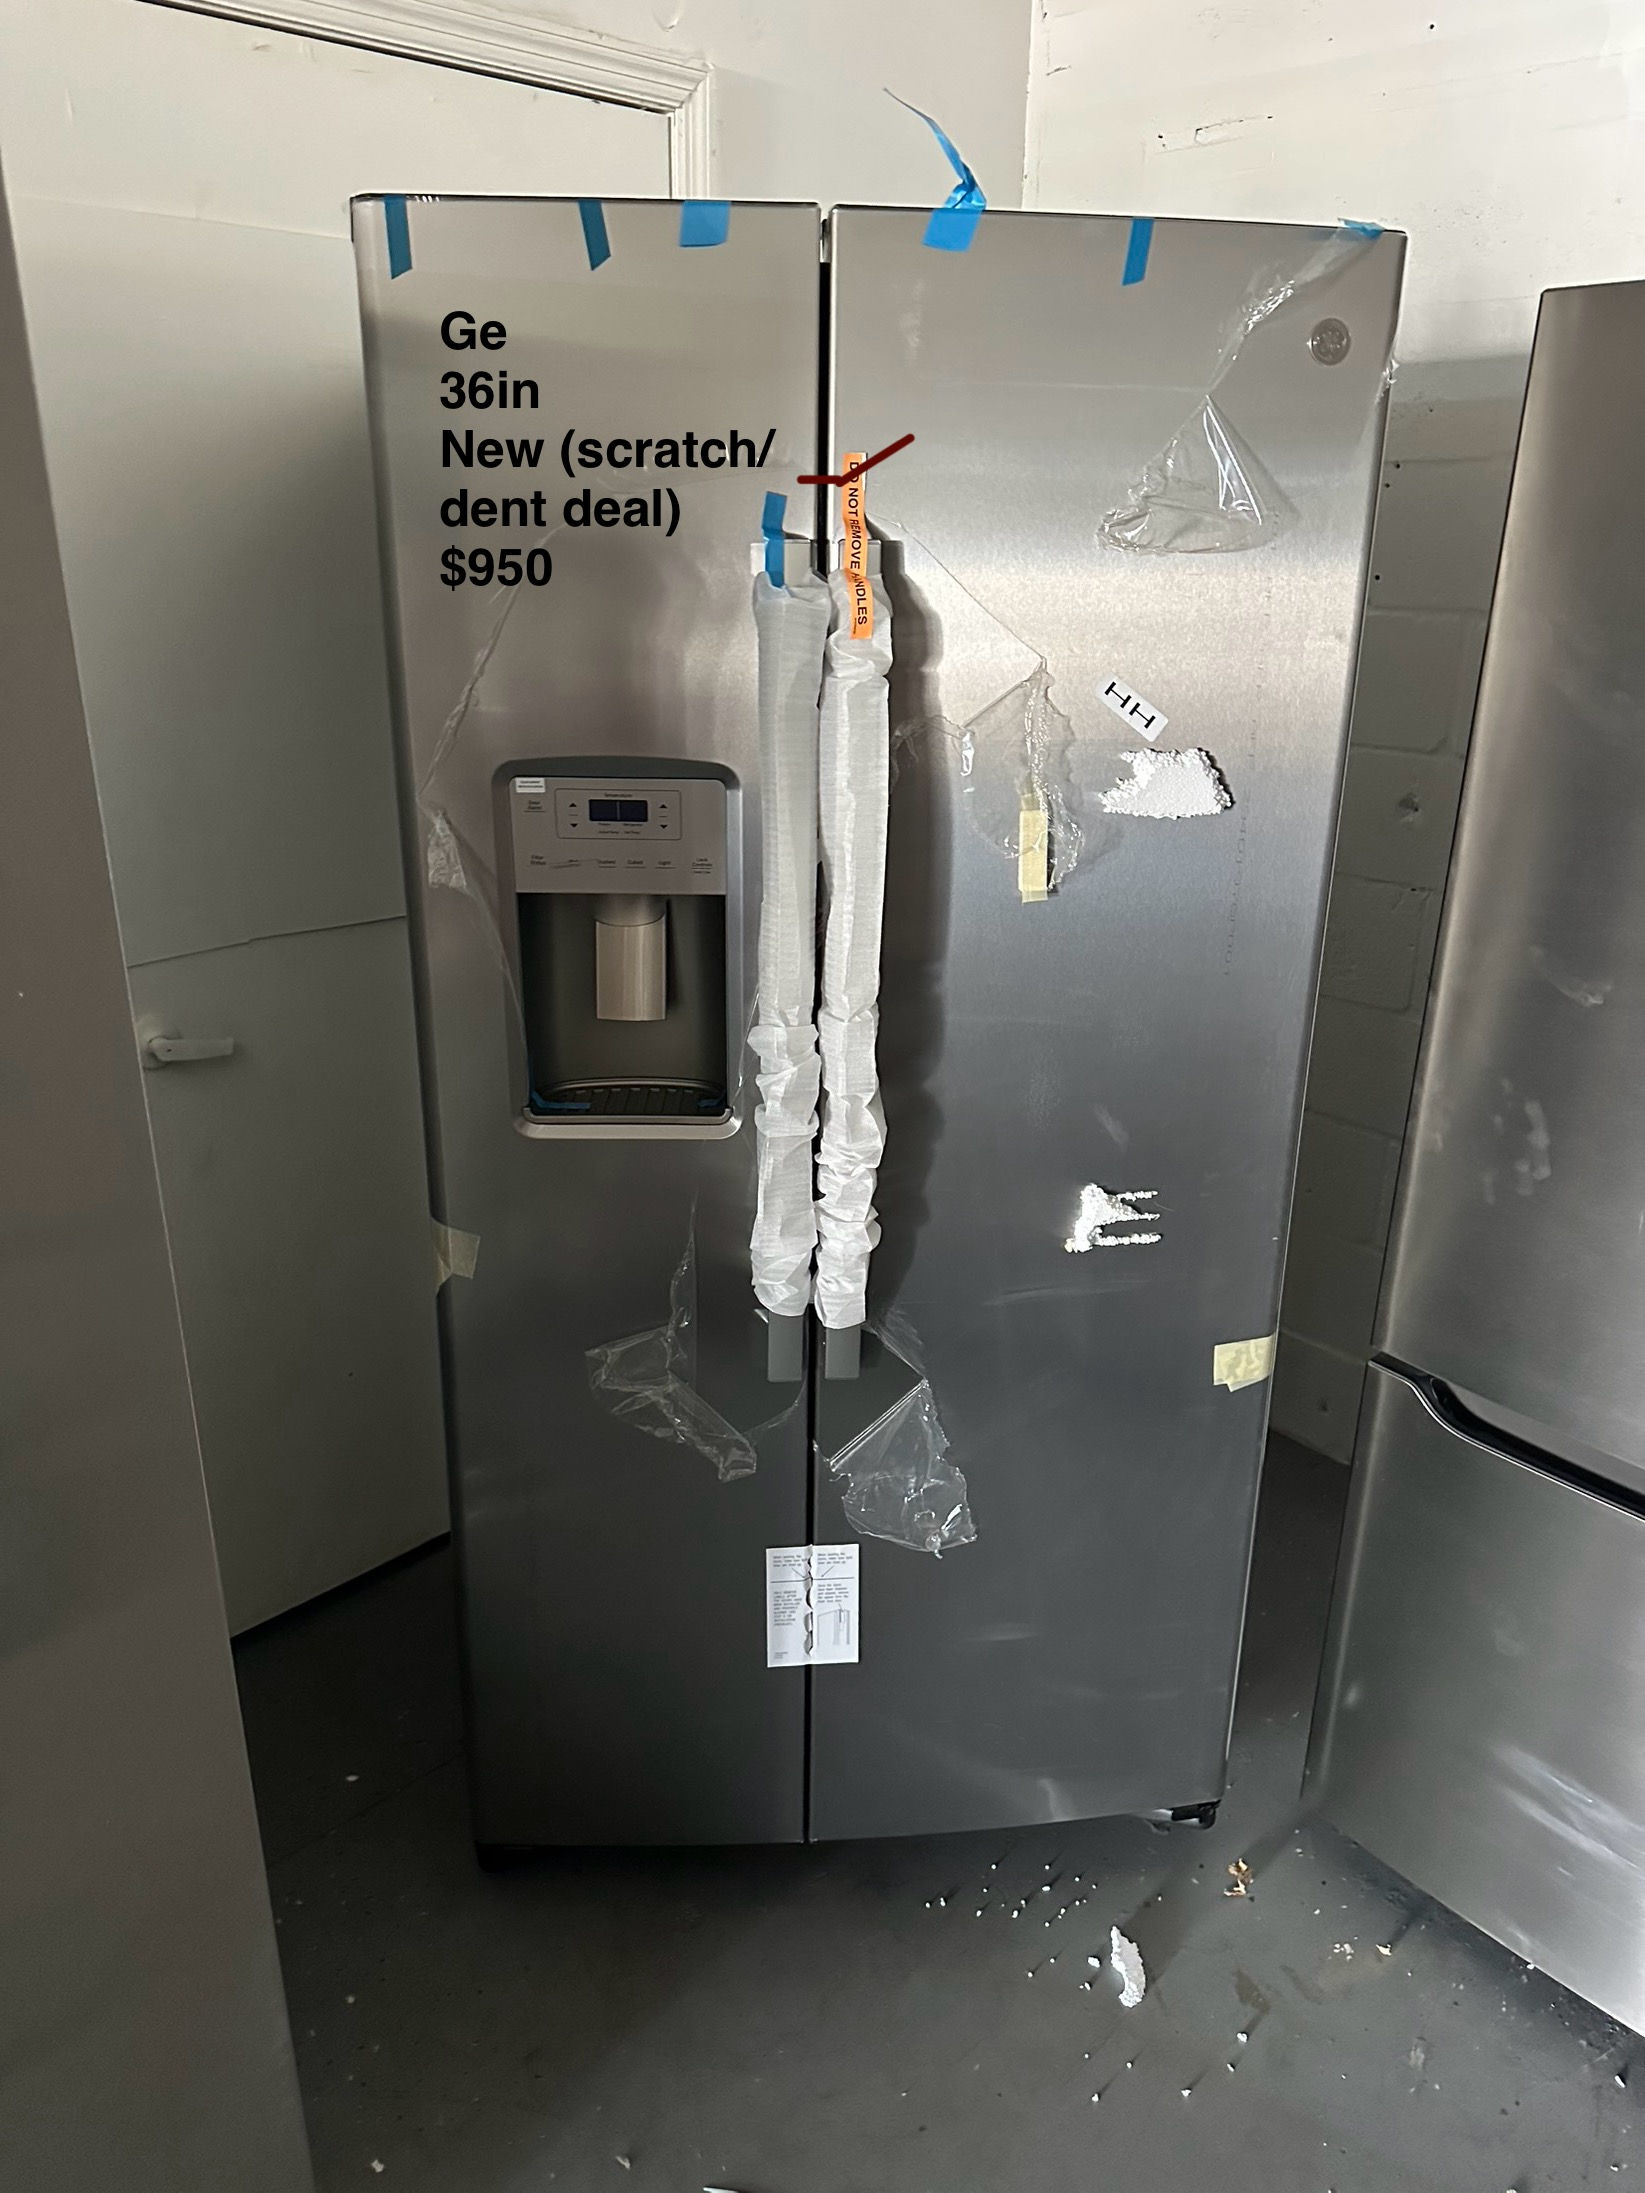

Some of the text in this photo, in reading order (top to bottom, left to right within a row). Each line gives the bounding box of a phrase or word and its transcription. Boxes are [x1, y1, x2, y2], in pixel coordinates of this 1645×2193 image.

[848, 487, 859, 518] NOT
[848, 519, 862, 570] REMOVE
[1104, 681, 1156, 729] HH
